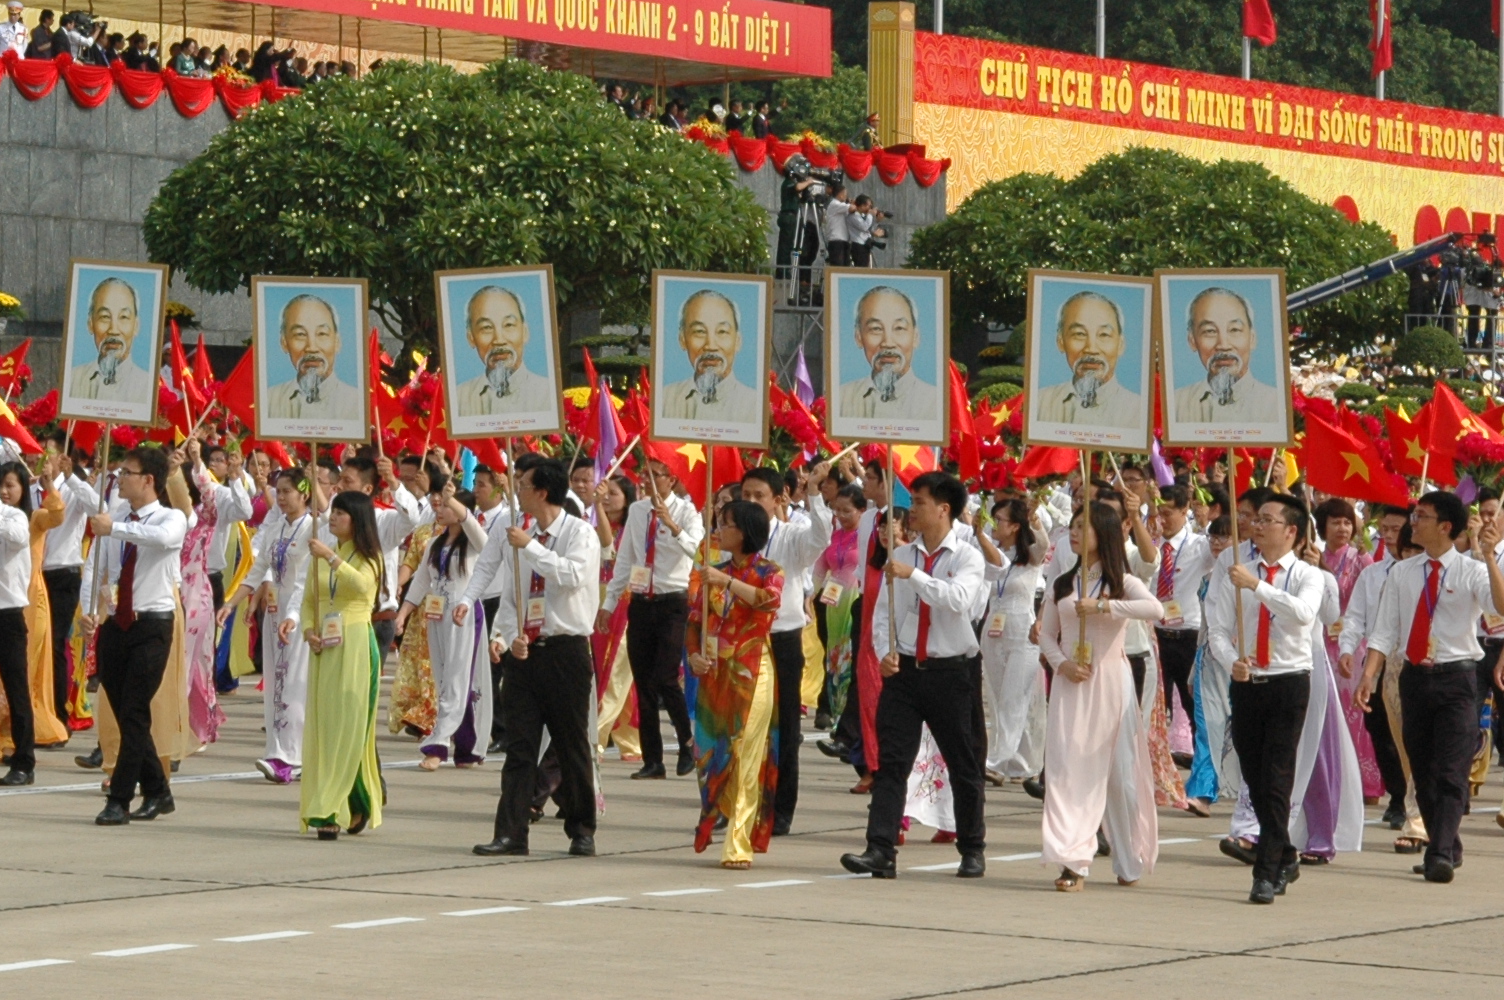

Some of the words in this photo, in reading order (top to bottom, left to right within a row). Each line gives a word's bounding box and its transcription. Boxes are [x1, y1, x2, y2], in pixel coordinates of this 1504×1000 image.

[710, 1, 740, 50] BẤT
[745, 11, 779, 61] DIỆT
[980, 53, 1028, 101] CHỦ
[1036, 65, 1093, 112] TỊCH
[1100, 64, 1133, 114] HỒ
[1141, 78, 1181, 121] CHÍ
[1186, 87, 1246, 131] MINH
[1279, 102, 1314, 146] ĐẠI
[1319, 98, 1371, 148] SỐNG
[1418, 123, 1482, 163] TRONG
